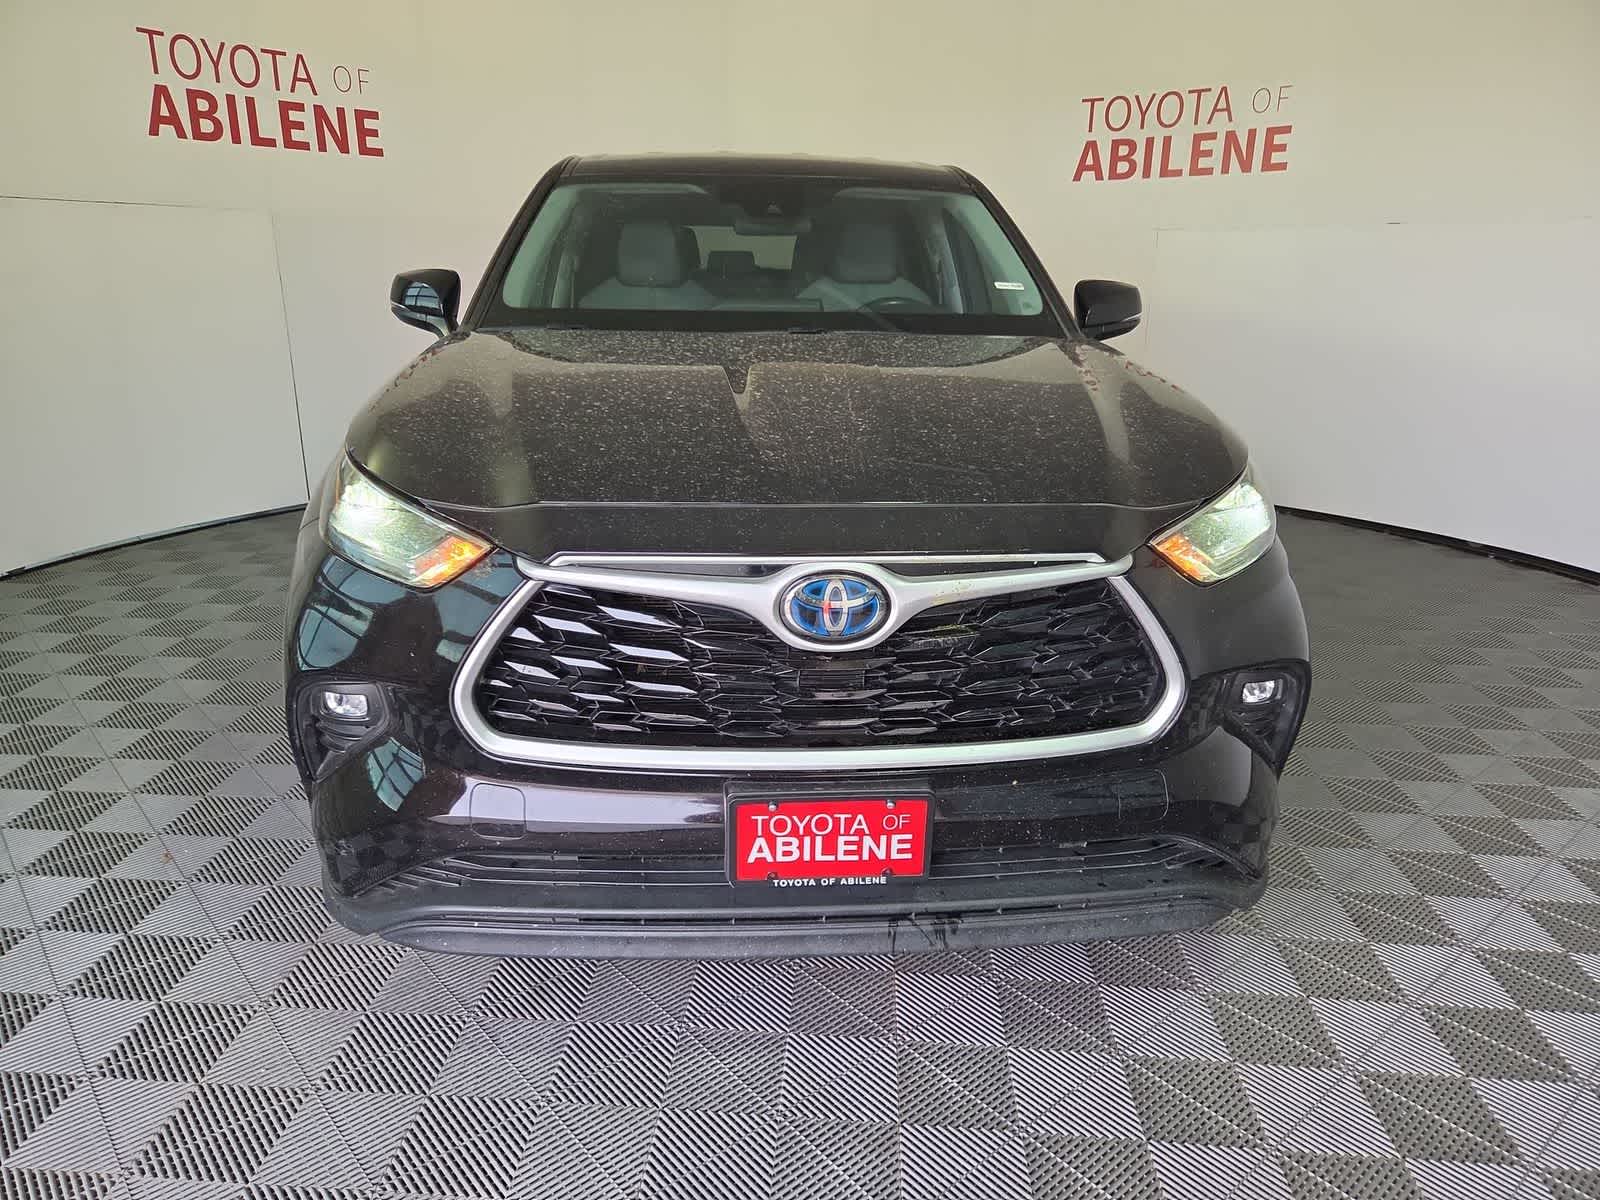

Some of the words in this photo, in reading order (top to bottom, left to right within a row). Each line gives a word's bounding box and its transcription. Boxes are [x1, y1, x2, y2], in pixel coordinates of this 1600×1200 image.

[136, 26, 318, 96] TOYOTA
[333, 65, 370, 94] OF
[148, 84, 384, 157] ABILENE
[1081, 86, 1233, 133] TOYOTA
[1252, 84, 1293, 114] OF
[1072, 125, 1292, 182] ABILENE
[747, 834, 913, 863] ABILENE
[751, 813, 870, 836] TOYOTA
[882, 814, 911, 830] OF
[773, 878, 816, 887] TOYOTA
[820, 877, 836, 886] OF
[840, 876, 887, 885] ABILENE
